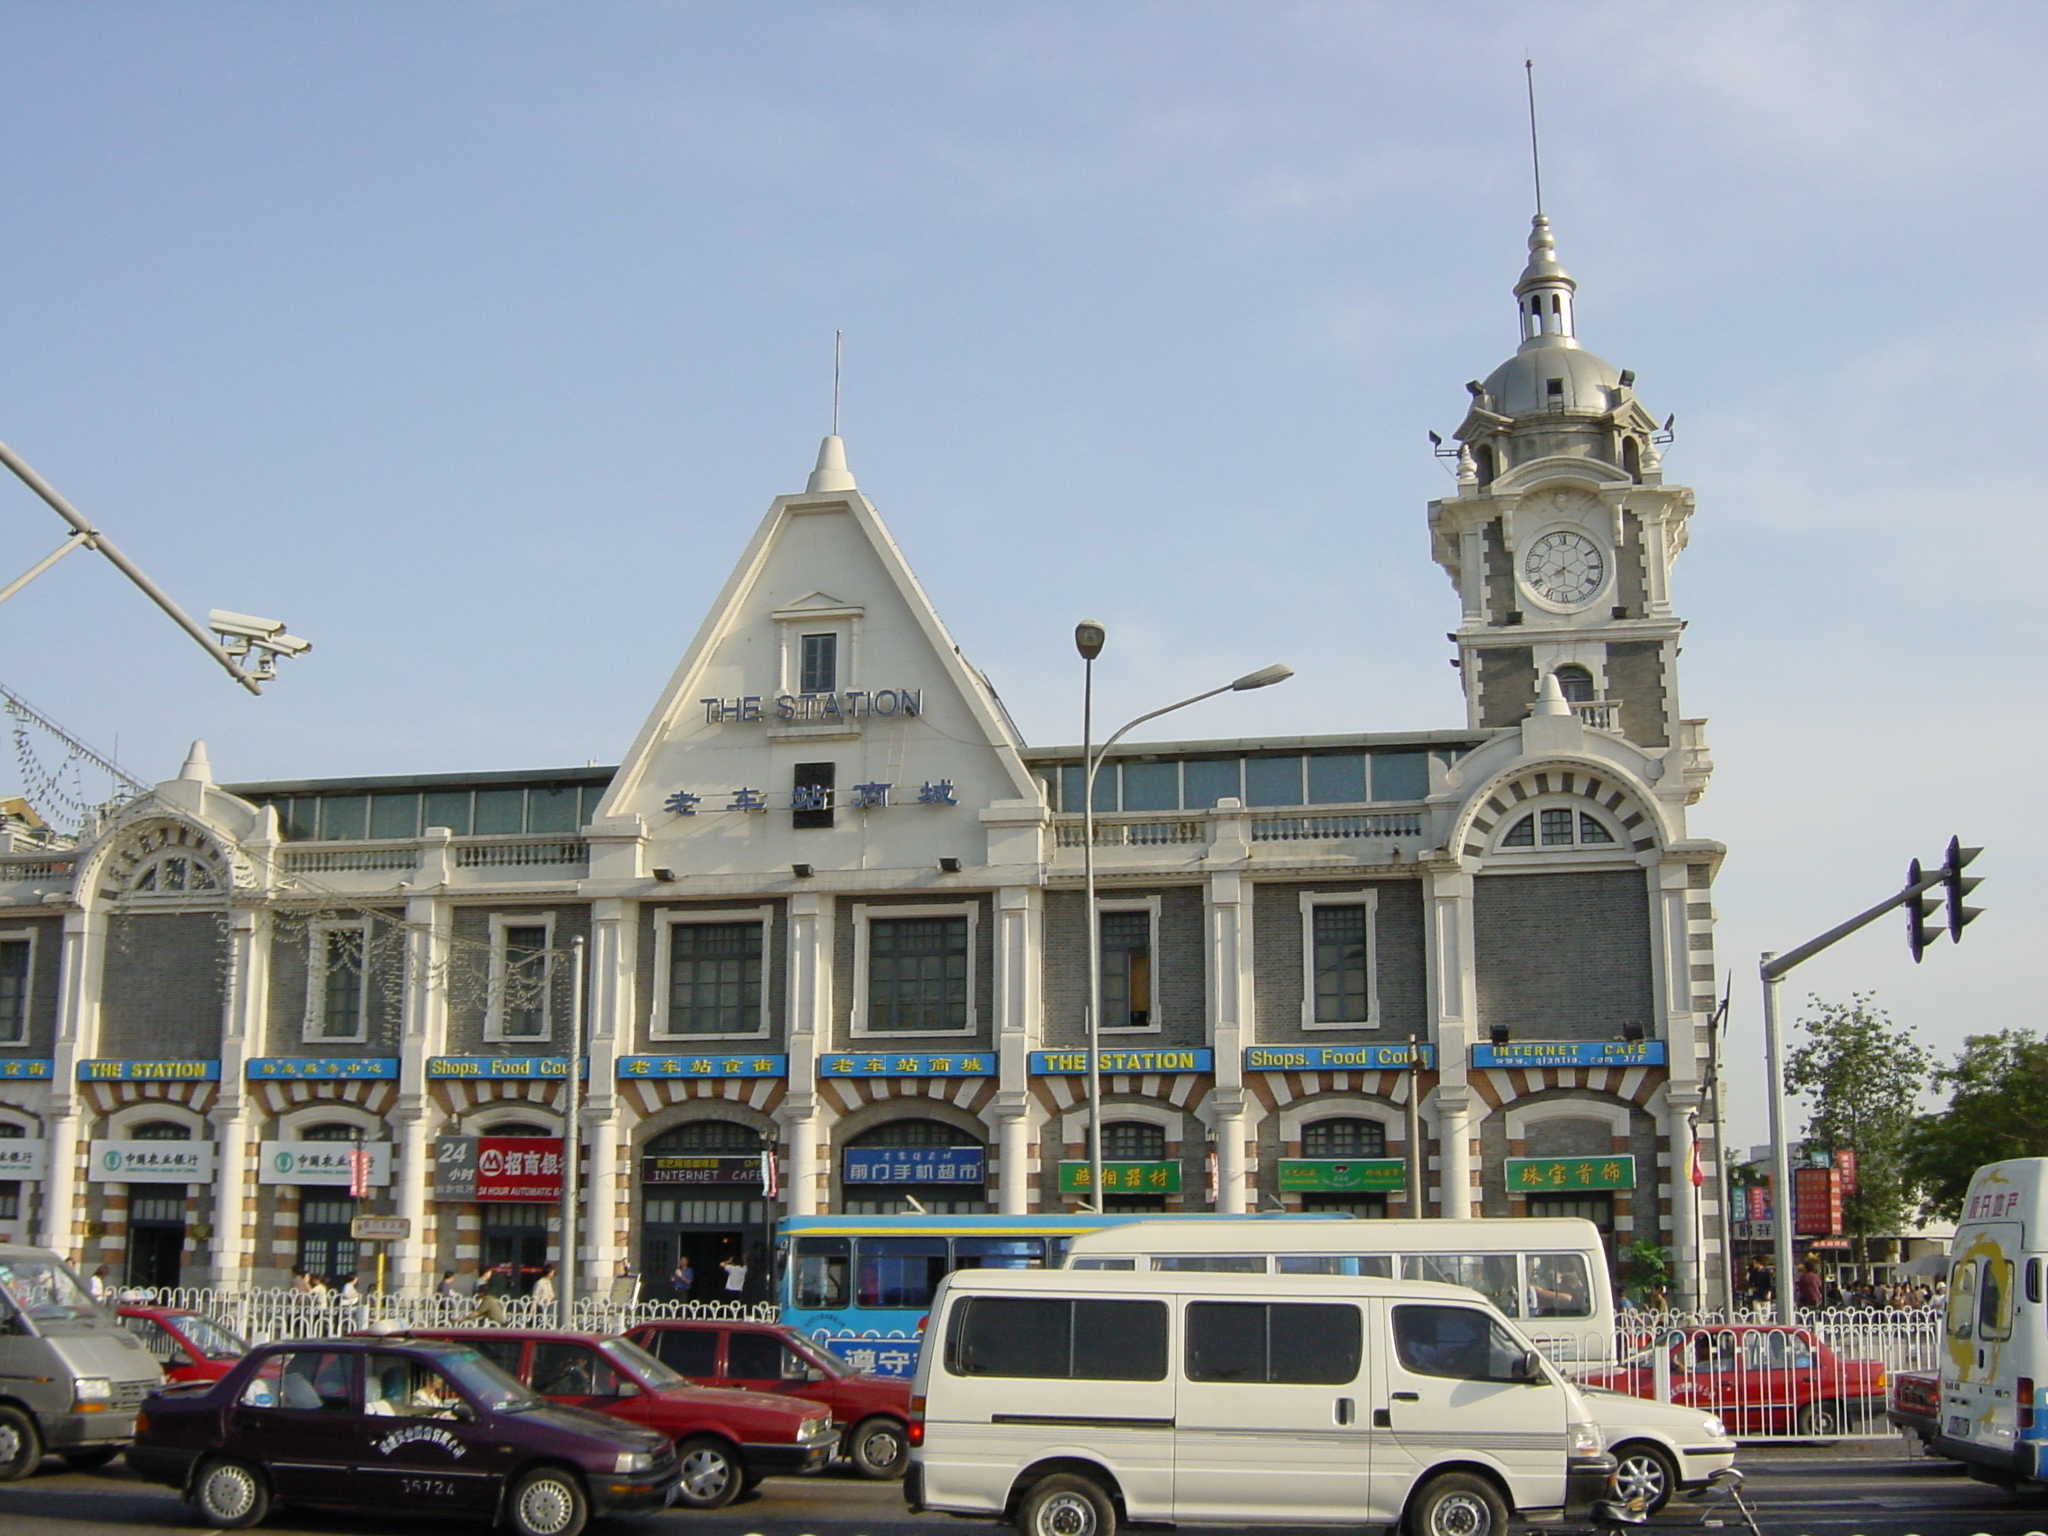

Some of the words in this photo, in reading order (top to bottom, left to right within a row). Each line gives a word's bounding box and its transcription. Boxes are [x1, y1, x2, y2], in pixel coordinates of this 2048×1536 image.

[700, 696, 763, 723] THE
[775, 689, 923, 721] STATION
[665, 779, 960, 816] 老车站商城
[1251, 1050, 1310, 1068] Shops.
[1322, 1049, 1367, 1065] Food
[1492, 1045, 1579, 1057] INTERNET
[1605, 1044, 1647, 1055] CAFE
[88, 1062, 123, 1078] THE
[131, 1062, 207, 1078] STATION
[431, 1060, 482, 1077] Shops.
[492, 1060, 530, 1074] Food
[628, 1059, 775, 1074] 老车站食街
[831, 1057, 984, 1073] 老车站商城
[1043, 1054, 1087, 1071] THE
[1098, 1053, 1195, 1070] STATION
[125, 1151, 199, 1167] 中国农业银行
[298, 1154, 375, 1168] 中国农业行
[438, 1143, 467, 1163] 24
[504, 1150, 566, 1177] 招商银
[850, 1163, 978, 1180] 前门手机超市
[653, 1170, 719, 1180] INTERNET
[732, 1169, 763, 1180] CAFE
[1521, 1162, 1621, 1186] 珠宝首饰
[844, 1349, 918, 1374] 遵守
